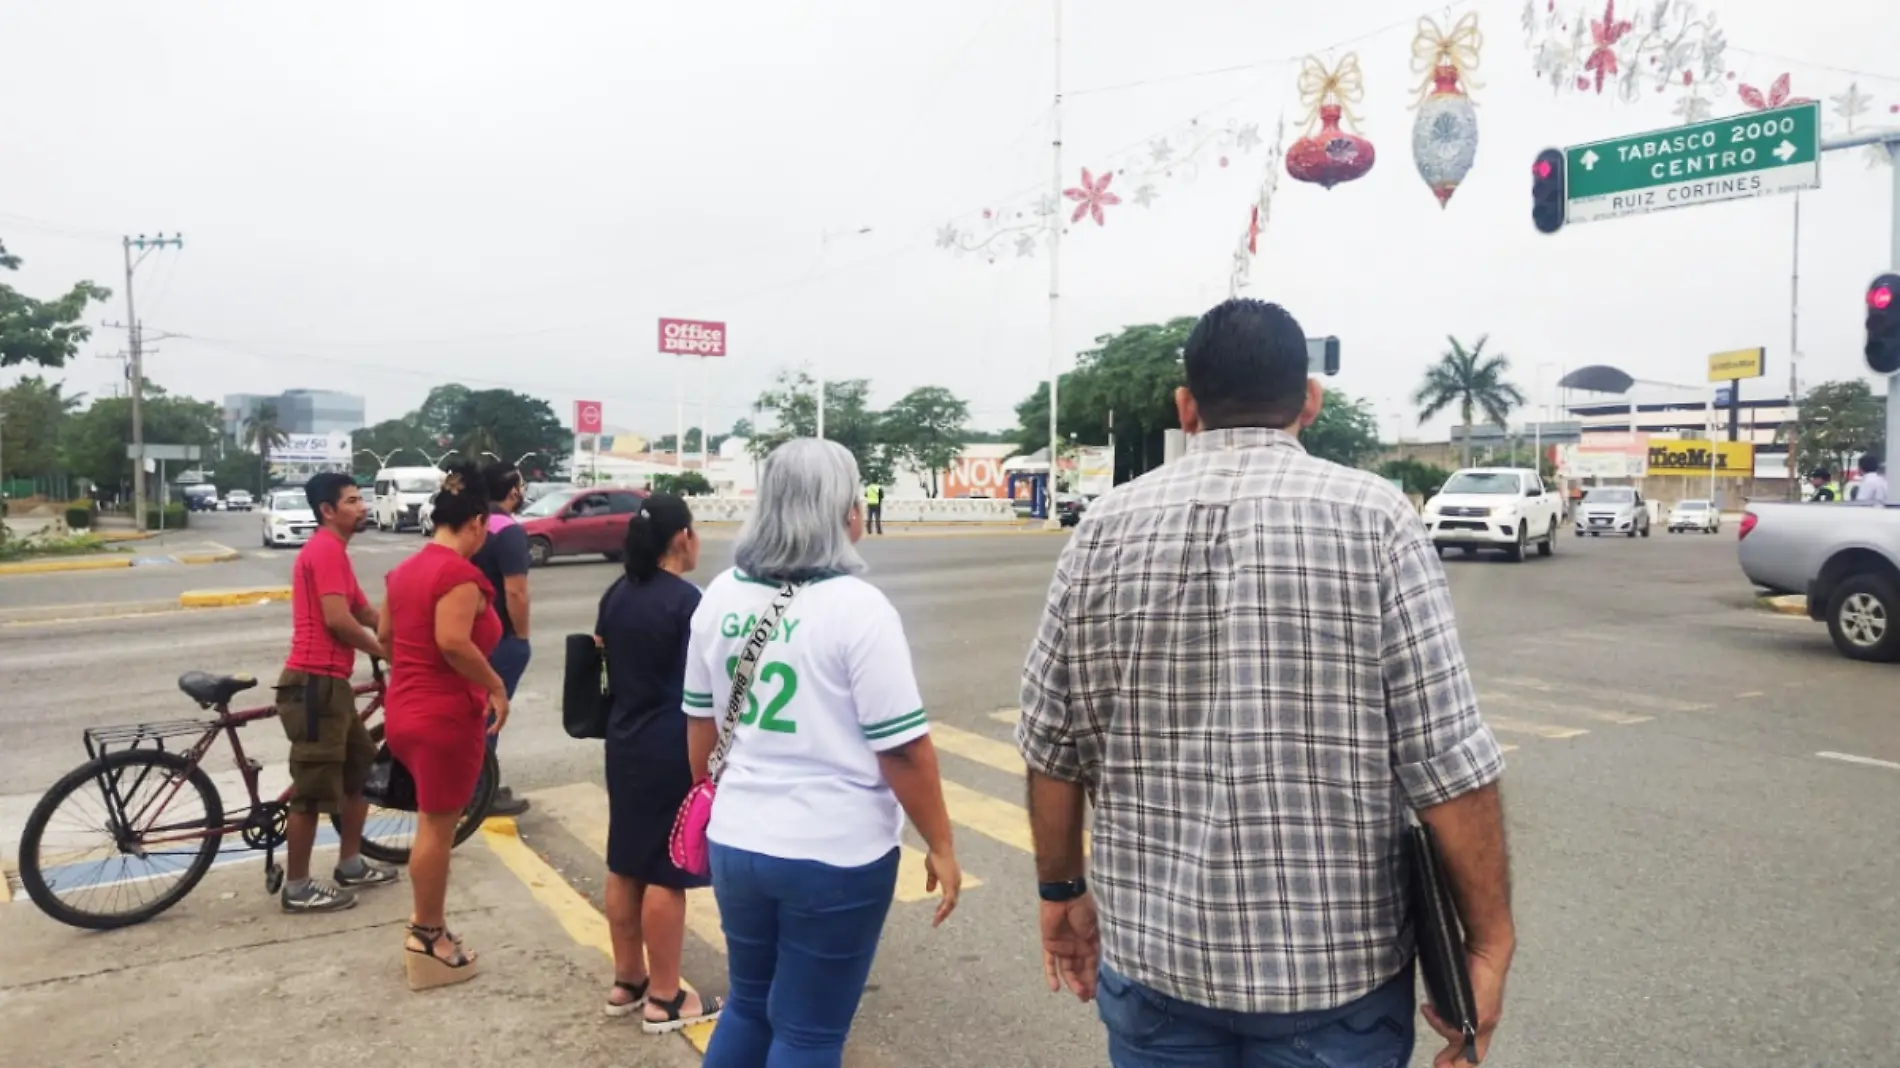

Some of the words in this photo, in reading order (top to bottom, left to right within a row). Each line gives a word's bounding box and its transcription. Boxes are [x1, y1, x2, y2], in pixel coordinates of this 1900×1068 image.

[1617, 130, 1717, 163] TABASCO
[1730, 116, 1795, 144] 2000
[1651, 147, 1757, 179] CENTRO
[1612, 192, 1655, 210] RUIZ
[1666, 175, 1761, 201] CORTINES
[664, 323, 722, 341] Office
[664, 338, 722, 353] DEPOT
[1650, 446, 1728, 469] fficeMax
[744, 618, 773, 662] LOLA
